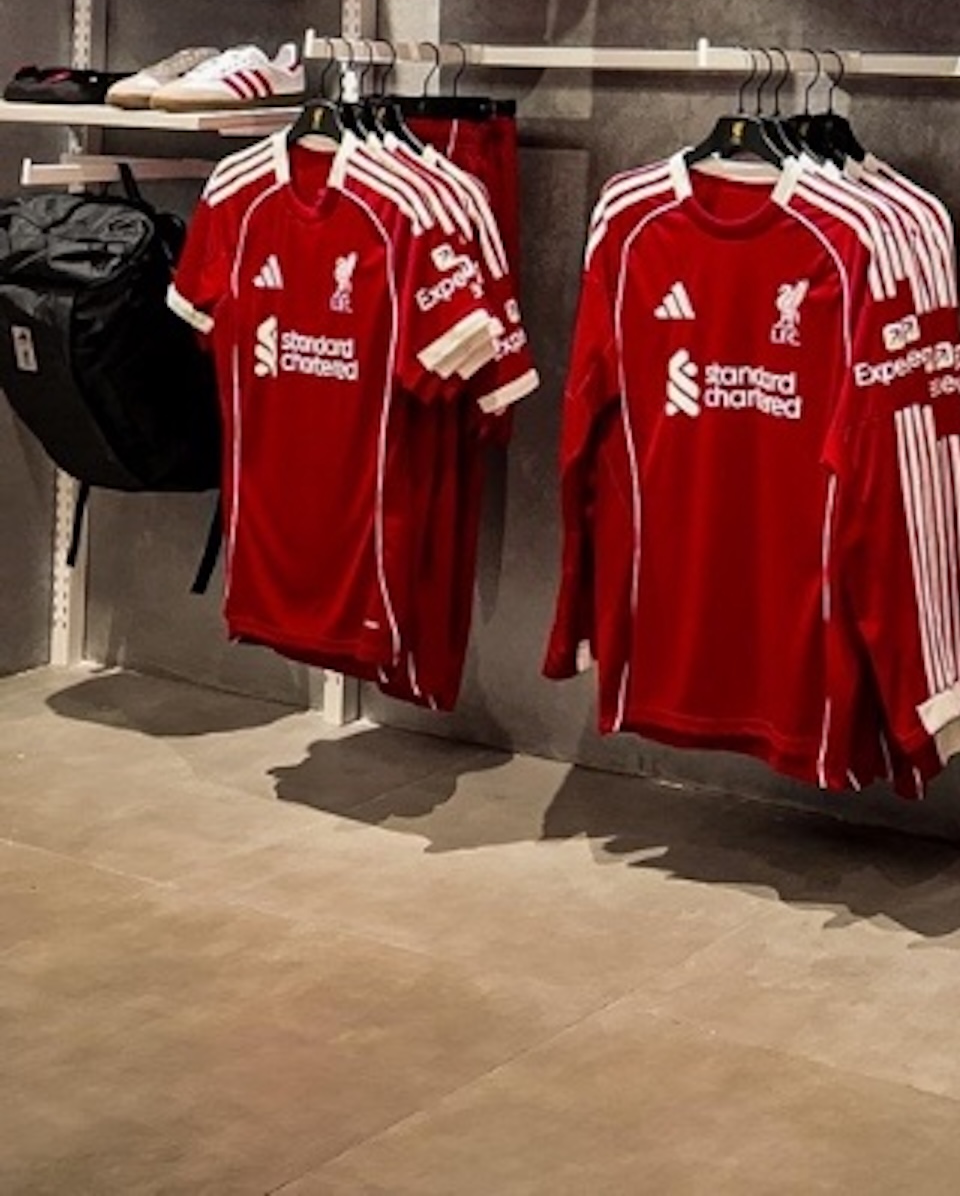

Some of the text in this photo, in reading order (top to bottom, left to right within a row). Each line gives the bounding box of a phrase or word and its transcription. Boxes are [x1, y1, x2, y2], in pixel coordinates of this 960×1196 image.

[280, 330, 356, 360] standard
[280, 352, 360, 381] chartered
[703, 361, 798, 396] standard
[703, 386, 802, 420] chartered
